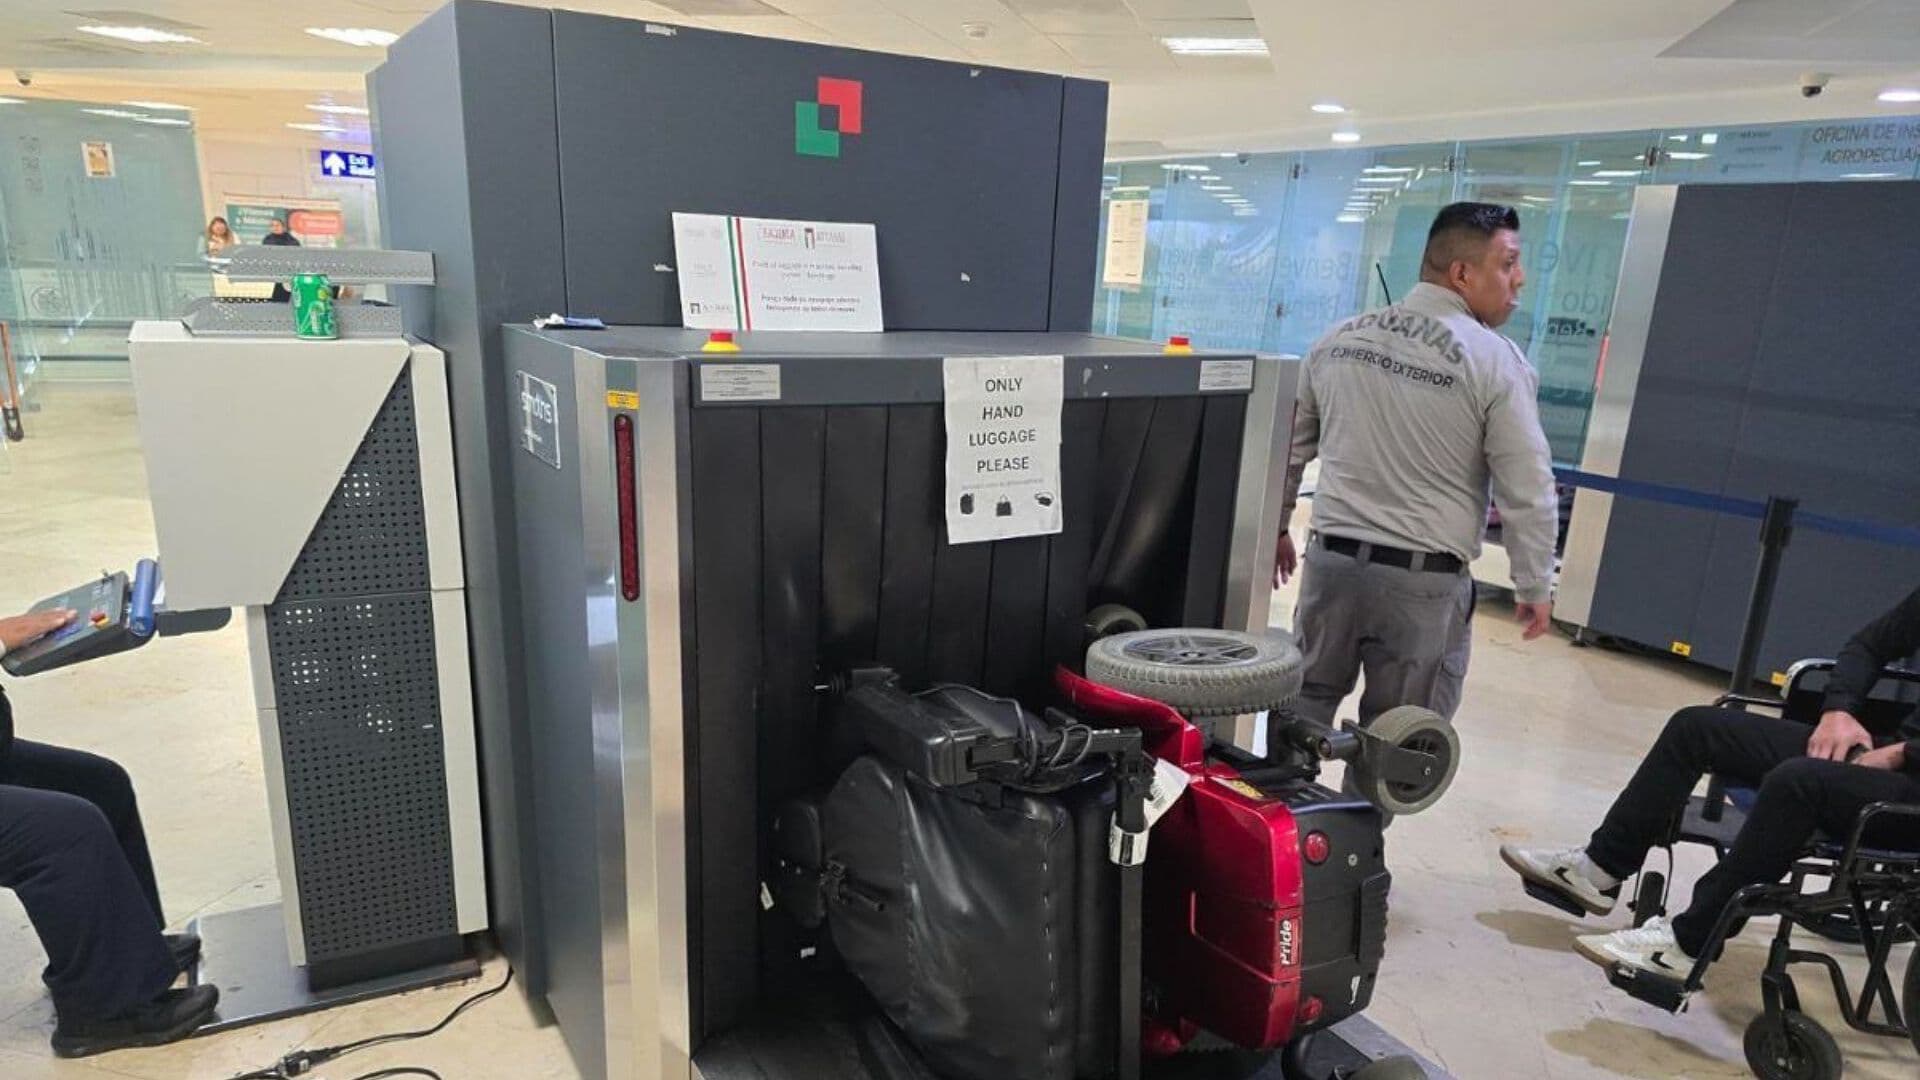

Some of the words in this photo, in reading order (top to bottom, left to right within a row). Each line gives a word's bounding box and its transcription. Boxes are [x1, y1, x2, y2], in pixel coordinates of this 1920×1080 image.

[1812, 125, 1869, 144] OFICINA
[1873, 123, 1897, 140] DE
[985, 377, 1023, 393] ONLY
[982, 405, 1023, 421] HAND
[969, 429, 1036, 447] LUGGAGE
[977, 456, 1030, 474] PLEASE
[1279, 919, 1292, 966] Pride
